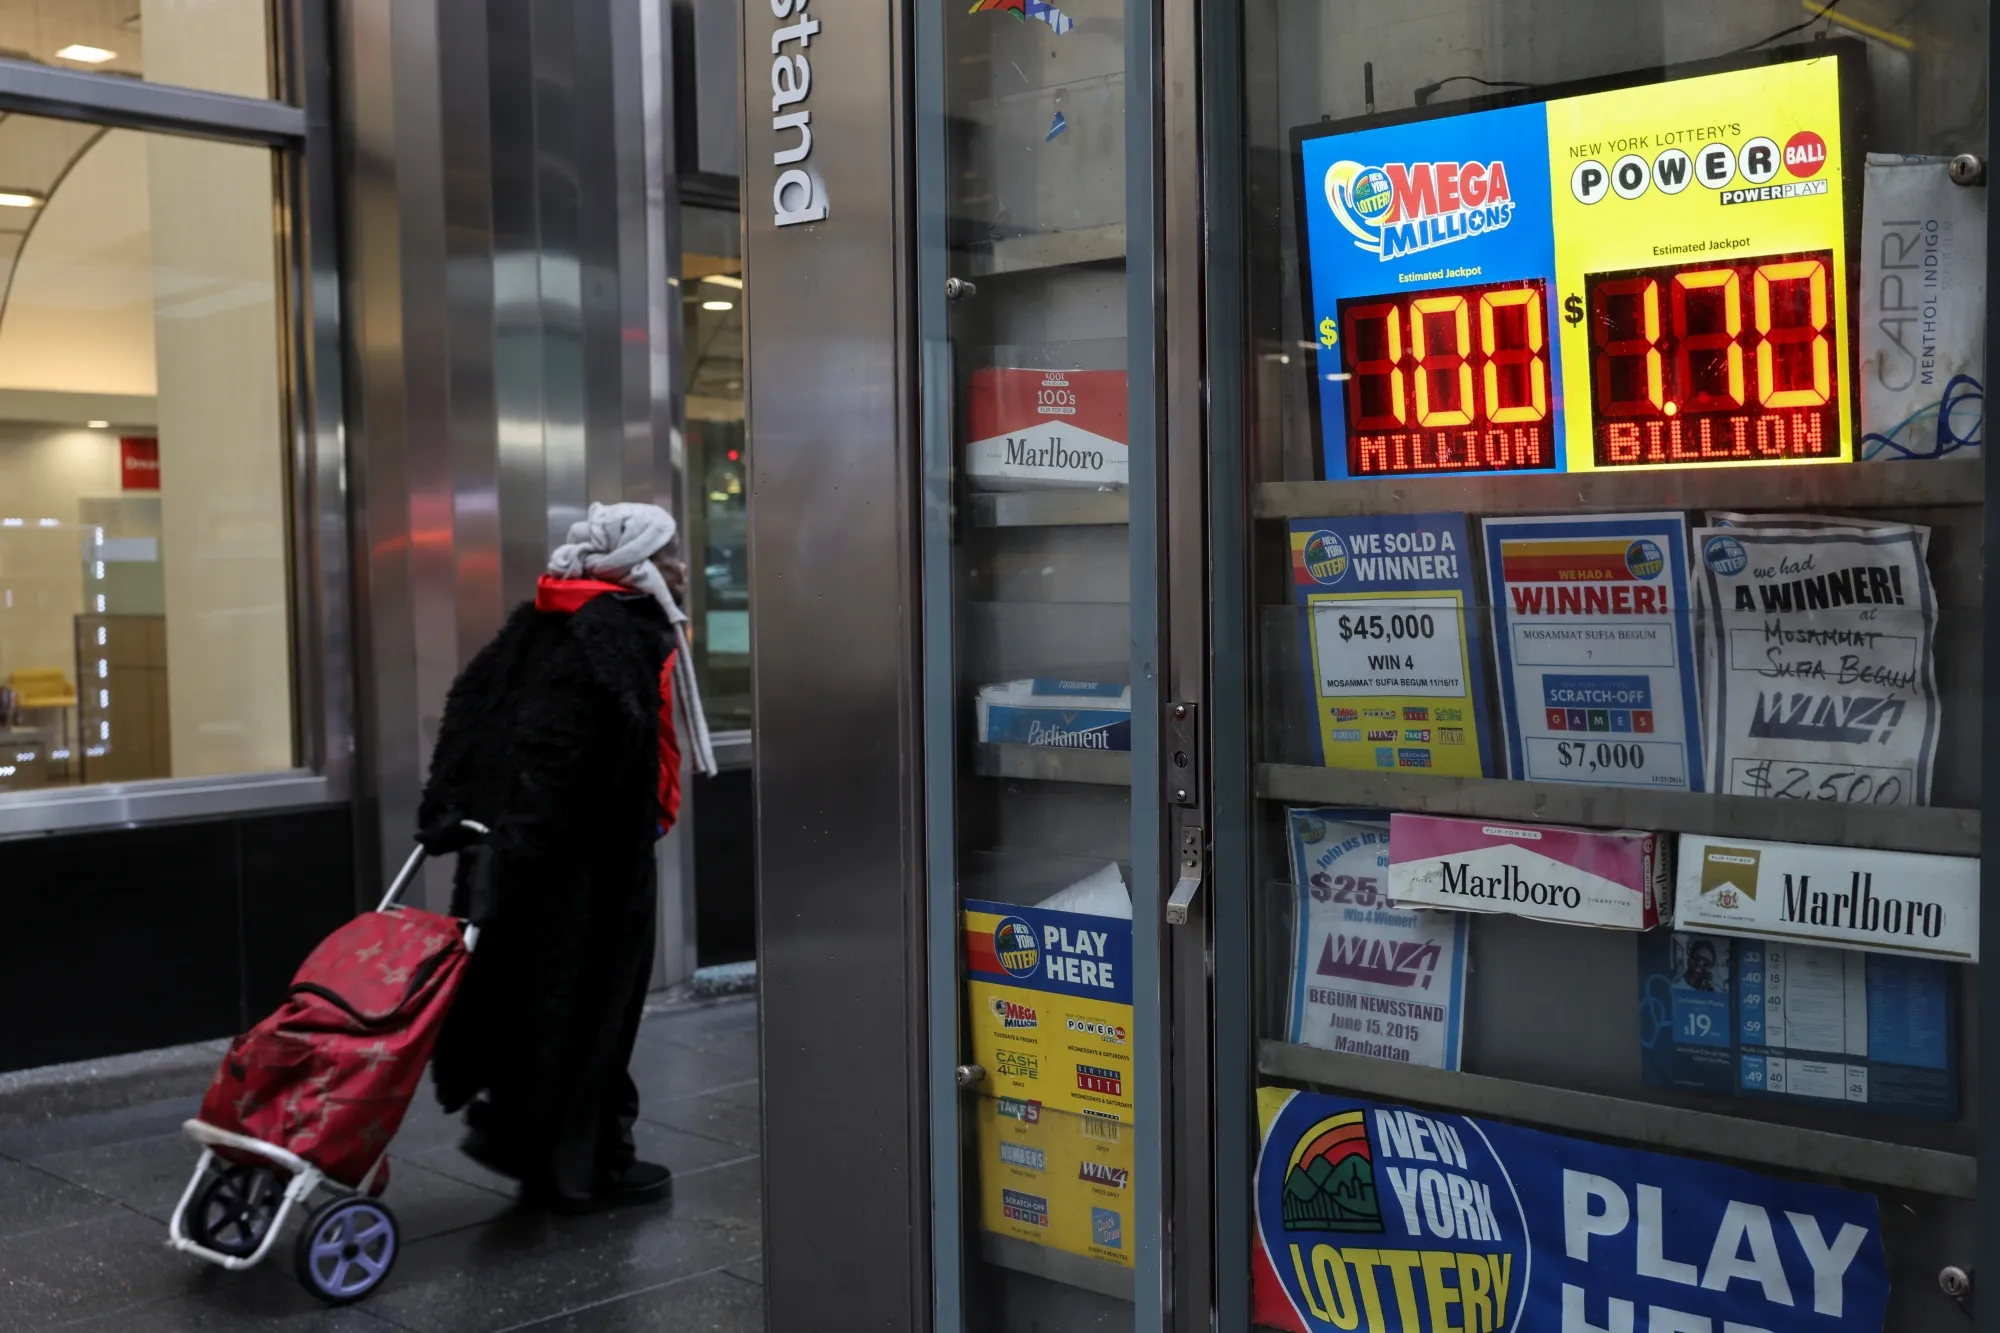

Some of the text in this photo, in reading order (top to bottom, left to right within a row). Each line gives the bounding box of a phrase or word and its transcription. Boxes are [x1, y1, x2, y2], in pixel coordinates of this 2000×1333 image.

[1570, 123, 1741, 158] NEW YORK LOTTERY'S
[1580, 143, 1825, 196] POWER BALL
[1384, 162, 1510, 223] MEGA
[1382, 204, 1512, 260] MILLIONS
[1653, 237, 1750, 256] Estimated Jackpot
[1398, 266, 1482, 283] Estimated Jackpot
[1878, 220, 1921, 391] CAPRI
[1921, 219, 1939, 384] MENTHOL INDIGO
[1643, 260, 1830, 417] 1.70
[1387, 288, 1547, 427] 100
[1037, 389, 1076, 406] 100's
[1609, 412, 1822, 461] BILLION
[1005, 437, 1104, 470] Marlboro
[1360, 428, 1540, 471] MILLION
[1321, 536, 1344, 558] NEW YORK
[1349, 531, 1456, 554] WE SOLD A
[1310, 556, 1346, 578] LOTTERY
[1353, 554, 1459, 581] WINNER!
[1558, 569, 1613, 580] WE HAD A
[1753, 554, 1816, 579] we had
[1511, 585, 1668, 615] WINNER!
[1735, 565, 1905, 614] A WINNER!
[1859, 608, 1878, 621] at
[1338, 613, 1435, 643] $45,000
[1524, 630, 1656, 640] MOSAMMAT SUFIA BEGUM
[1368, 655, 1414, 670] WIN 4
[1327, 679, 1373, 688] MOSAMMAT
[1375, 678, 1399, 687] SUFIA
[1400, 679, 1428, 687] BEGUM
[1550, 689, 1644, 703] SCRATCH-OFF
[1552, 714, 1647, 726] GAMES
[1028, 720, 1110, 749] Parliament
[1557, 741, 1644, 772] $7,000
[1440, 861, 1581, 909] Marlboro
[1655, 840, 1668, 917] Marlboro
[1779, 871, 1943, 938] Marlboro
[1013, 923, 1035, 949] NEW YORK
[1044, 925, 1108, 958] PLAY
[1000, 949, 1038, 969] LOTTERY
[1770, 953, 1780, 963] 12
[1046, 954, 1115, 989] HERE
[1005, 1001, 1037, 1020] MEGA
[1309, 988, 1444, 1022] BEGUM NEWSSTAND
[1768, 996, 1781, 1006] 40
[1005, 1019, 1037, 1028] MILLIONS
[1068, 1020, 1114, 1036] POWER
[1329, 1012, 1362, 1032] June
[1386, 1022, 1419, 1042] 2015
[996, 1052, 1038, 1068] CASH
[1103, 1052, 1130, 1061] SATURDAYS
[1335, 1035, 1410, 1062] Manhattan
[997, 1065, 1038, 1080] 4LIFE
[1079, 1076, 1120, 1094] LOTTO
[1770, 1073, 1783, 1083] 40
[1000, 1100, 1038, 1121] TAKE 5
[1106, 1099, 1132, 1109] SATURDAYS
[1001, 1145, 1044, 1168] NUMBERS
[1374, 1109, 1502, 1241] NEW YORK
[1005, 1196, 1045, 1212] SCRATCH-OFF
[1097, 1216, 1115, 1232] Quick
[1563, 1168, 1869, 1318] PLAY
[1289, 1243, 1512, 1333] LOTTERY
